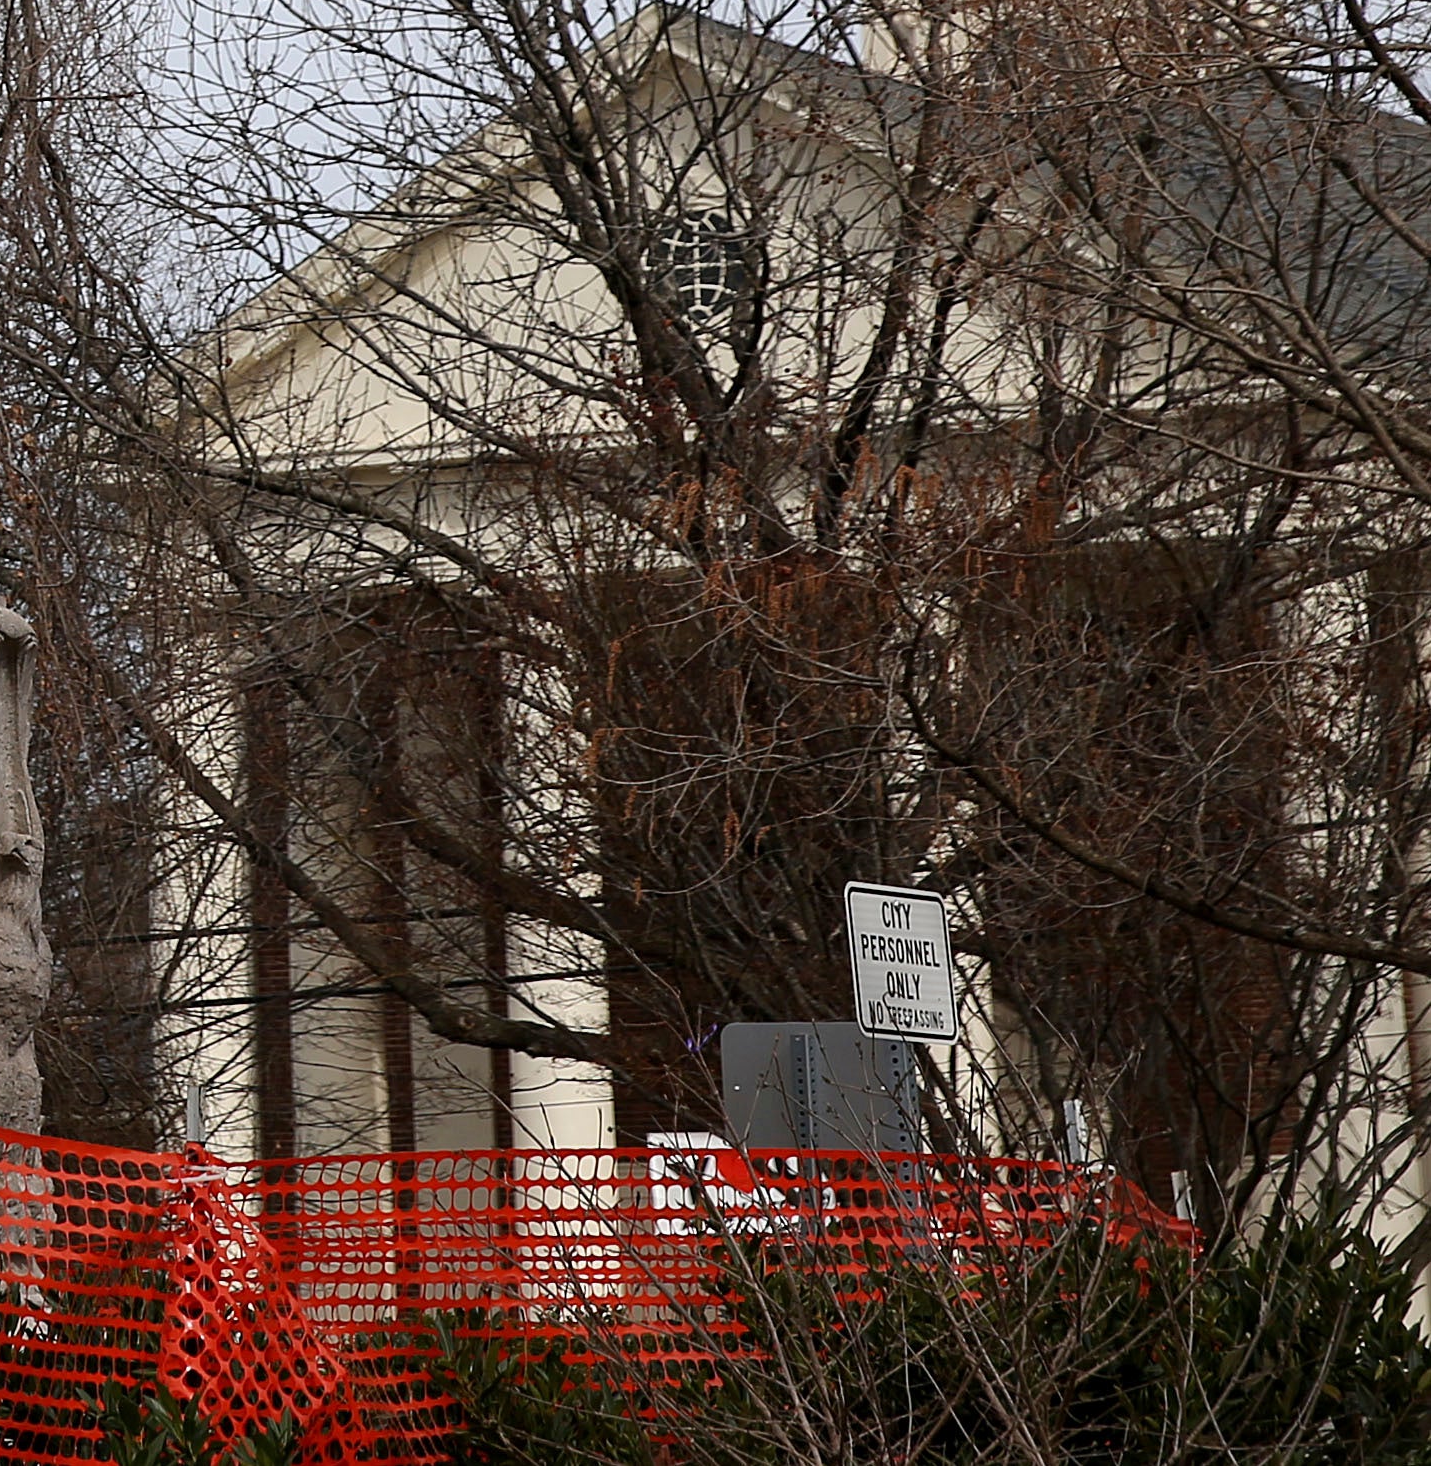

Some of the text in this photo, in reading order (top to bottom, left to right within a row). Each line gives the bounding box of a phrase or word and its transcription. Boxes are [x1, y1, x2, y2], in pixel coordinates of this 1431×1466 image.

[881, 901, 911, 930] CITY
[860, 934, 940, 967] PERSONNEL
[886, 971, 920, 1000] ONLY
[868, 1000, 884, 1024] NO
